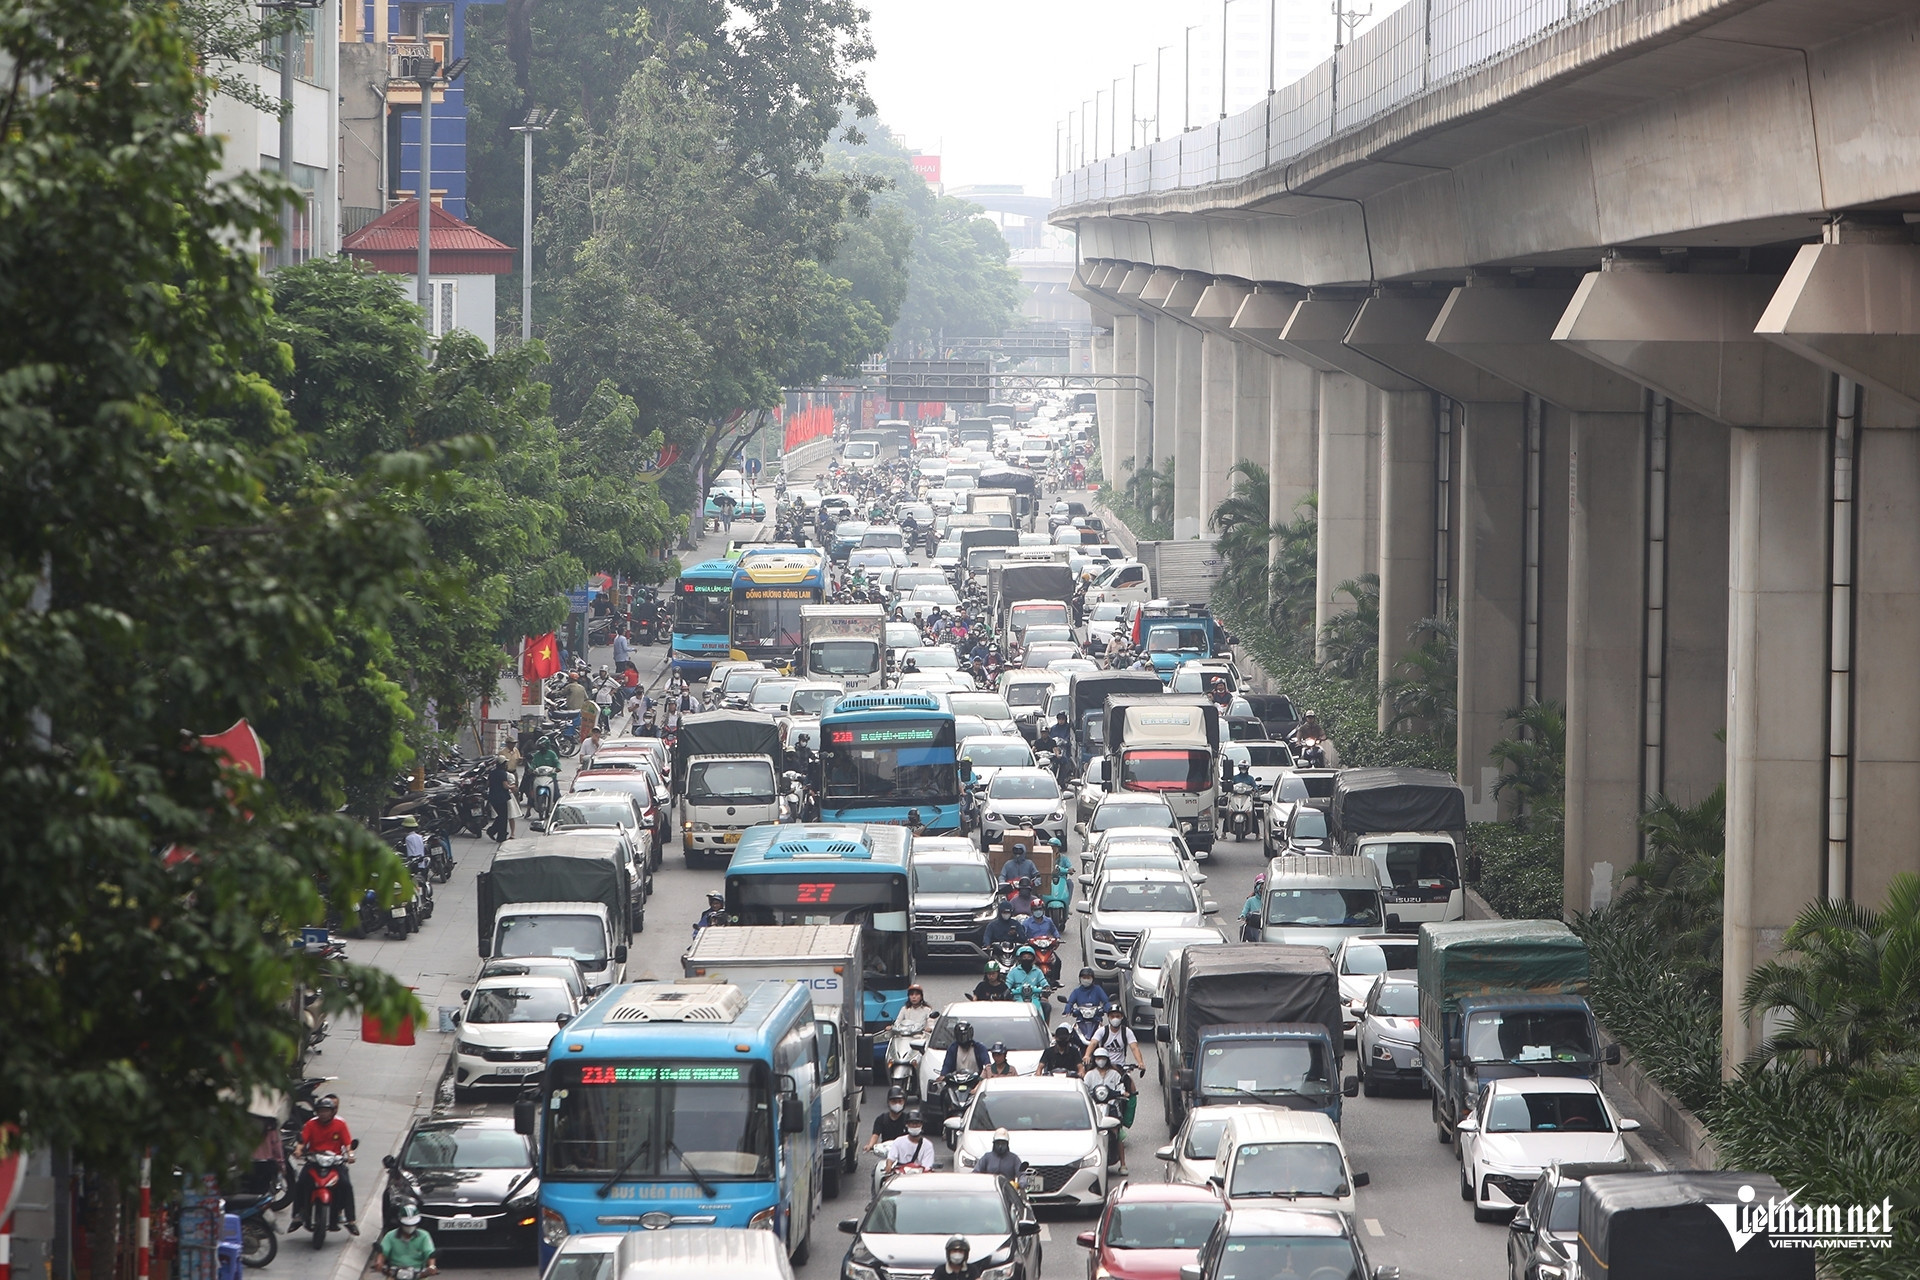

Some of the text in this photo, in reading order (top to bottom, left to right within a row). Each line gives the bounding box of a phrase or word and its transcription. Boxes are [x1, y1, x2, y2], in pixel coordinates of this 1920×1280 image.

[783, 589, 798, 599] SÔNG
[799, 591, 811, 599] LAM
[845, 680, 859, 688] HUY
[797, 882, 837, 903] 27
[611, 1186, 635, 1199] BUS
